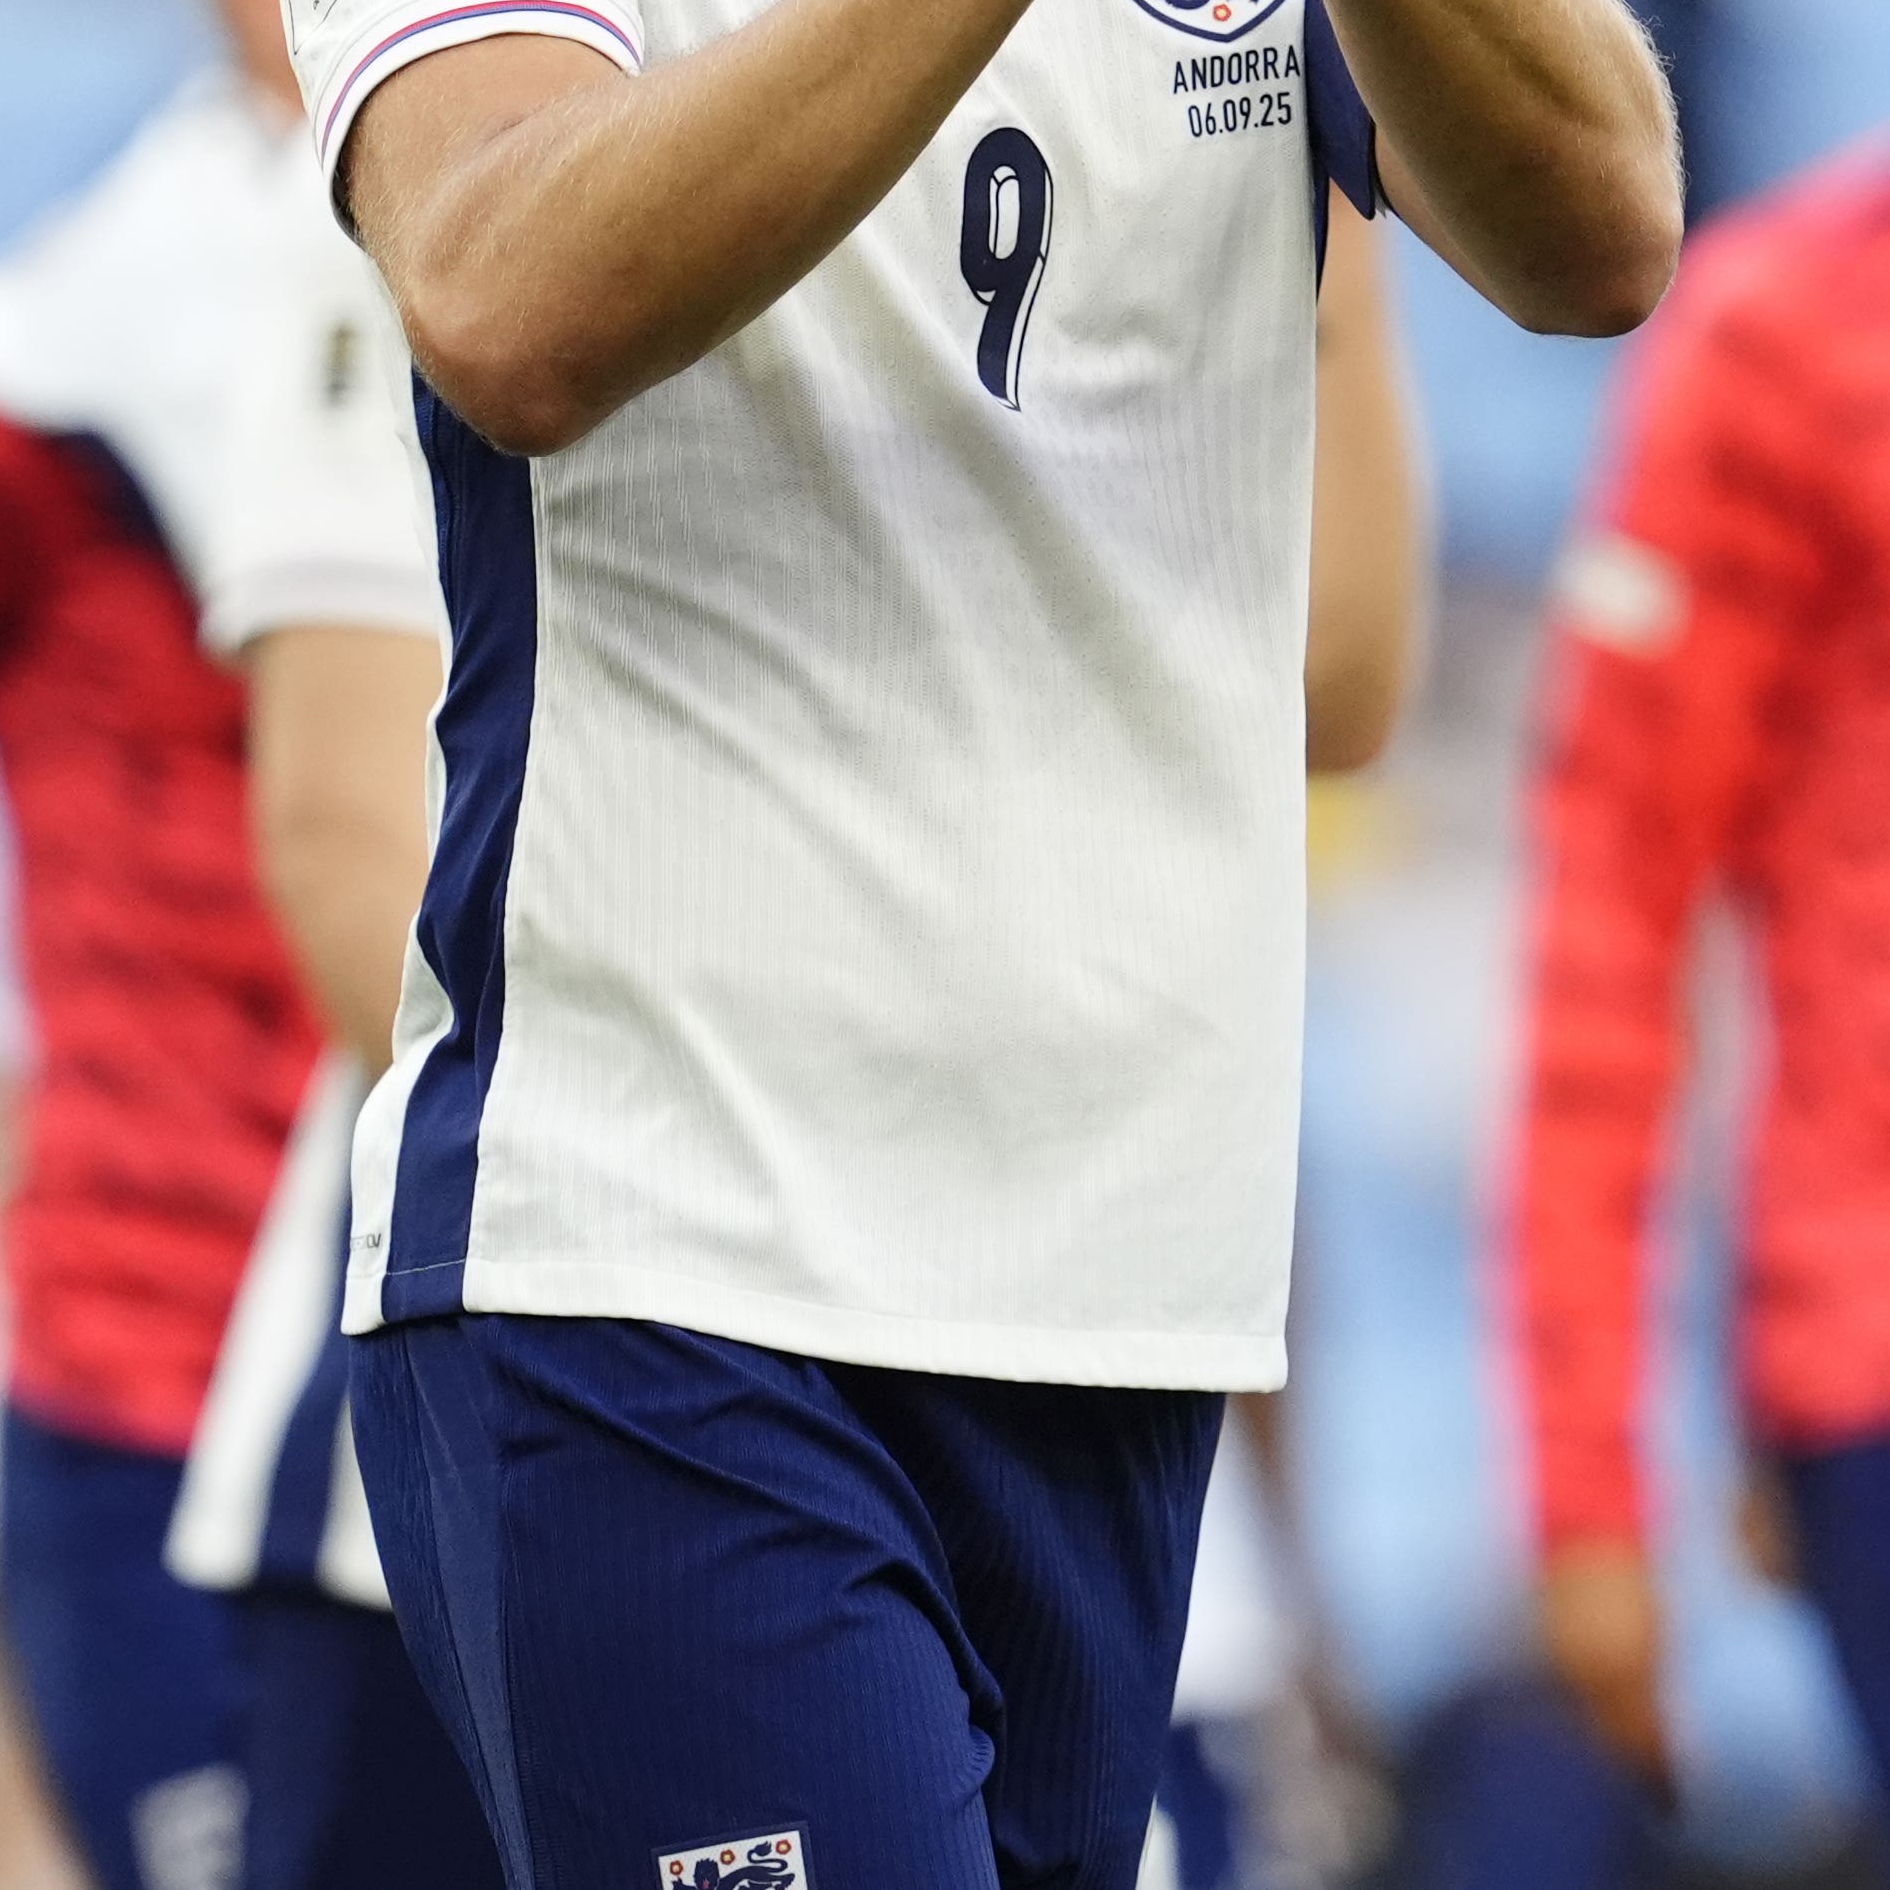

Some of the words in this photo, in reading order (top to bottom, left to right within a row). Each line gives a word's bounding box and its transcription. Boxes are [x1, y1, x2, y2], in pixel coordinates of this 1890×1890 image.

[1173, 44, 1301, 95] ANDORRA
[1187, 91, 1292, 138] 06.09.25
[960, 126, 1054, 412] 9
